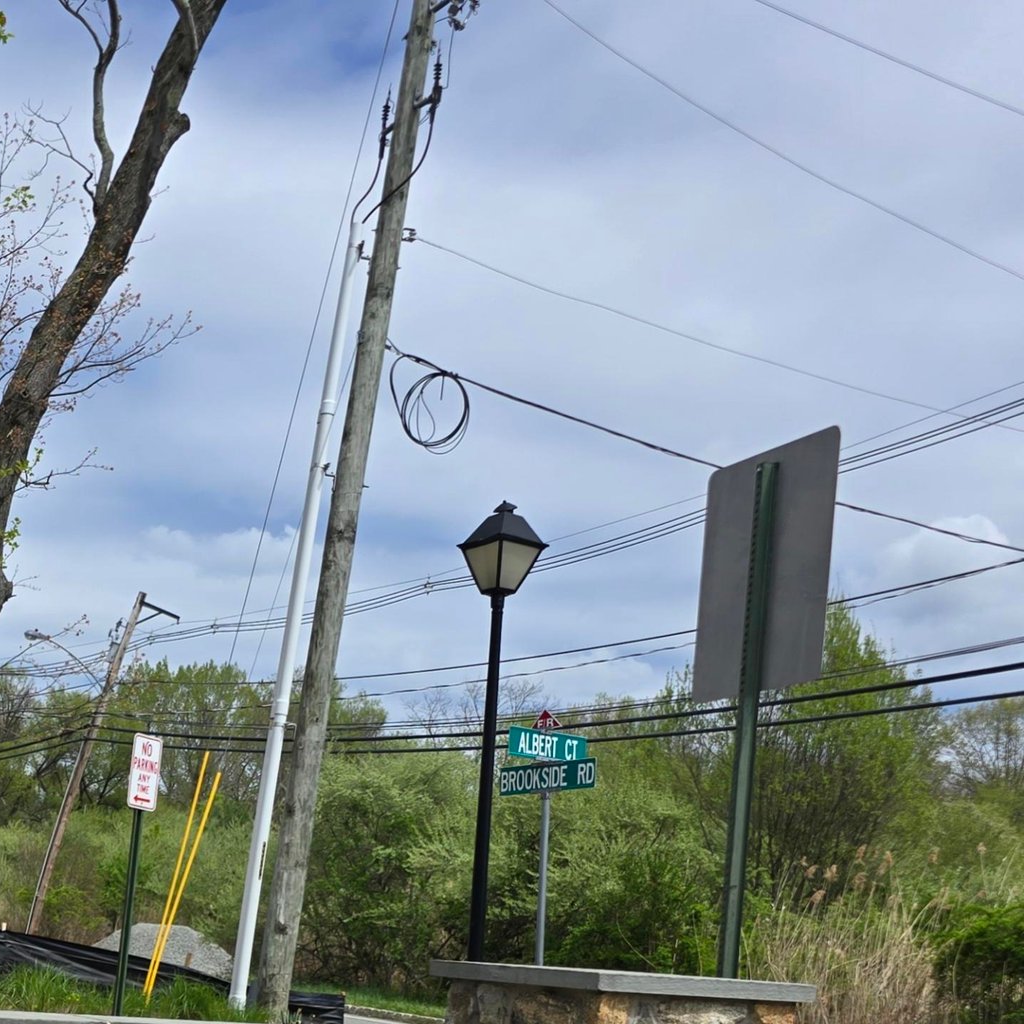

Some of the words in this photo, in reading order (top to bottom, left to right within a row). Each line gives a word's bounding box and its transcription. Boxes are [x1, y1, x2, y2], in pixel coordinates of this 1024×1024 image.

[142, 742, 152, 757] NO
[518, 731, 558, 757] ALBERT
[565, 739, 578, 761] CT
[134, 756, 158, 774] PARKING
[137, 774, 150, 784] ANY
[501, 765, 568, 793] BROOKSIDE
[577, 763, 595, 786] RD
[137, 783, 150, 794] TIME
